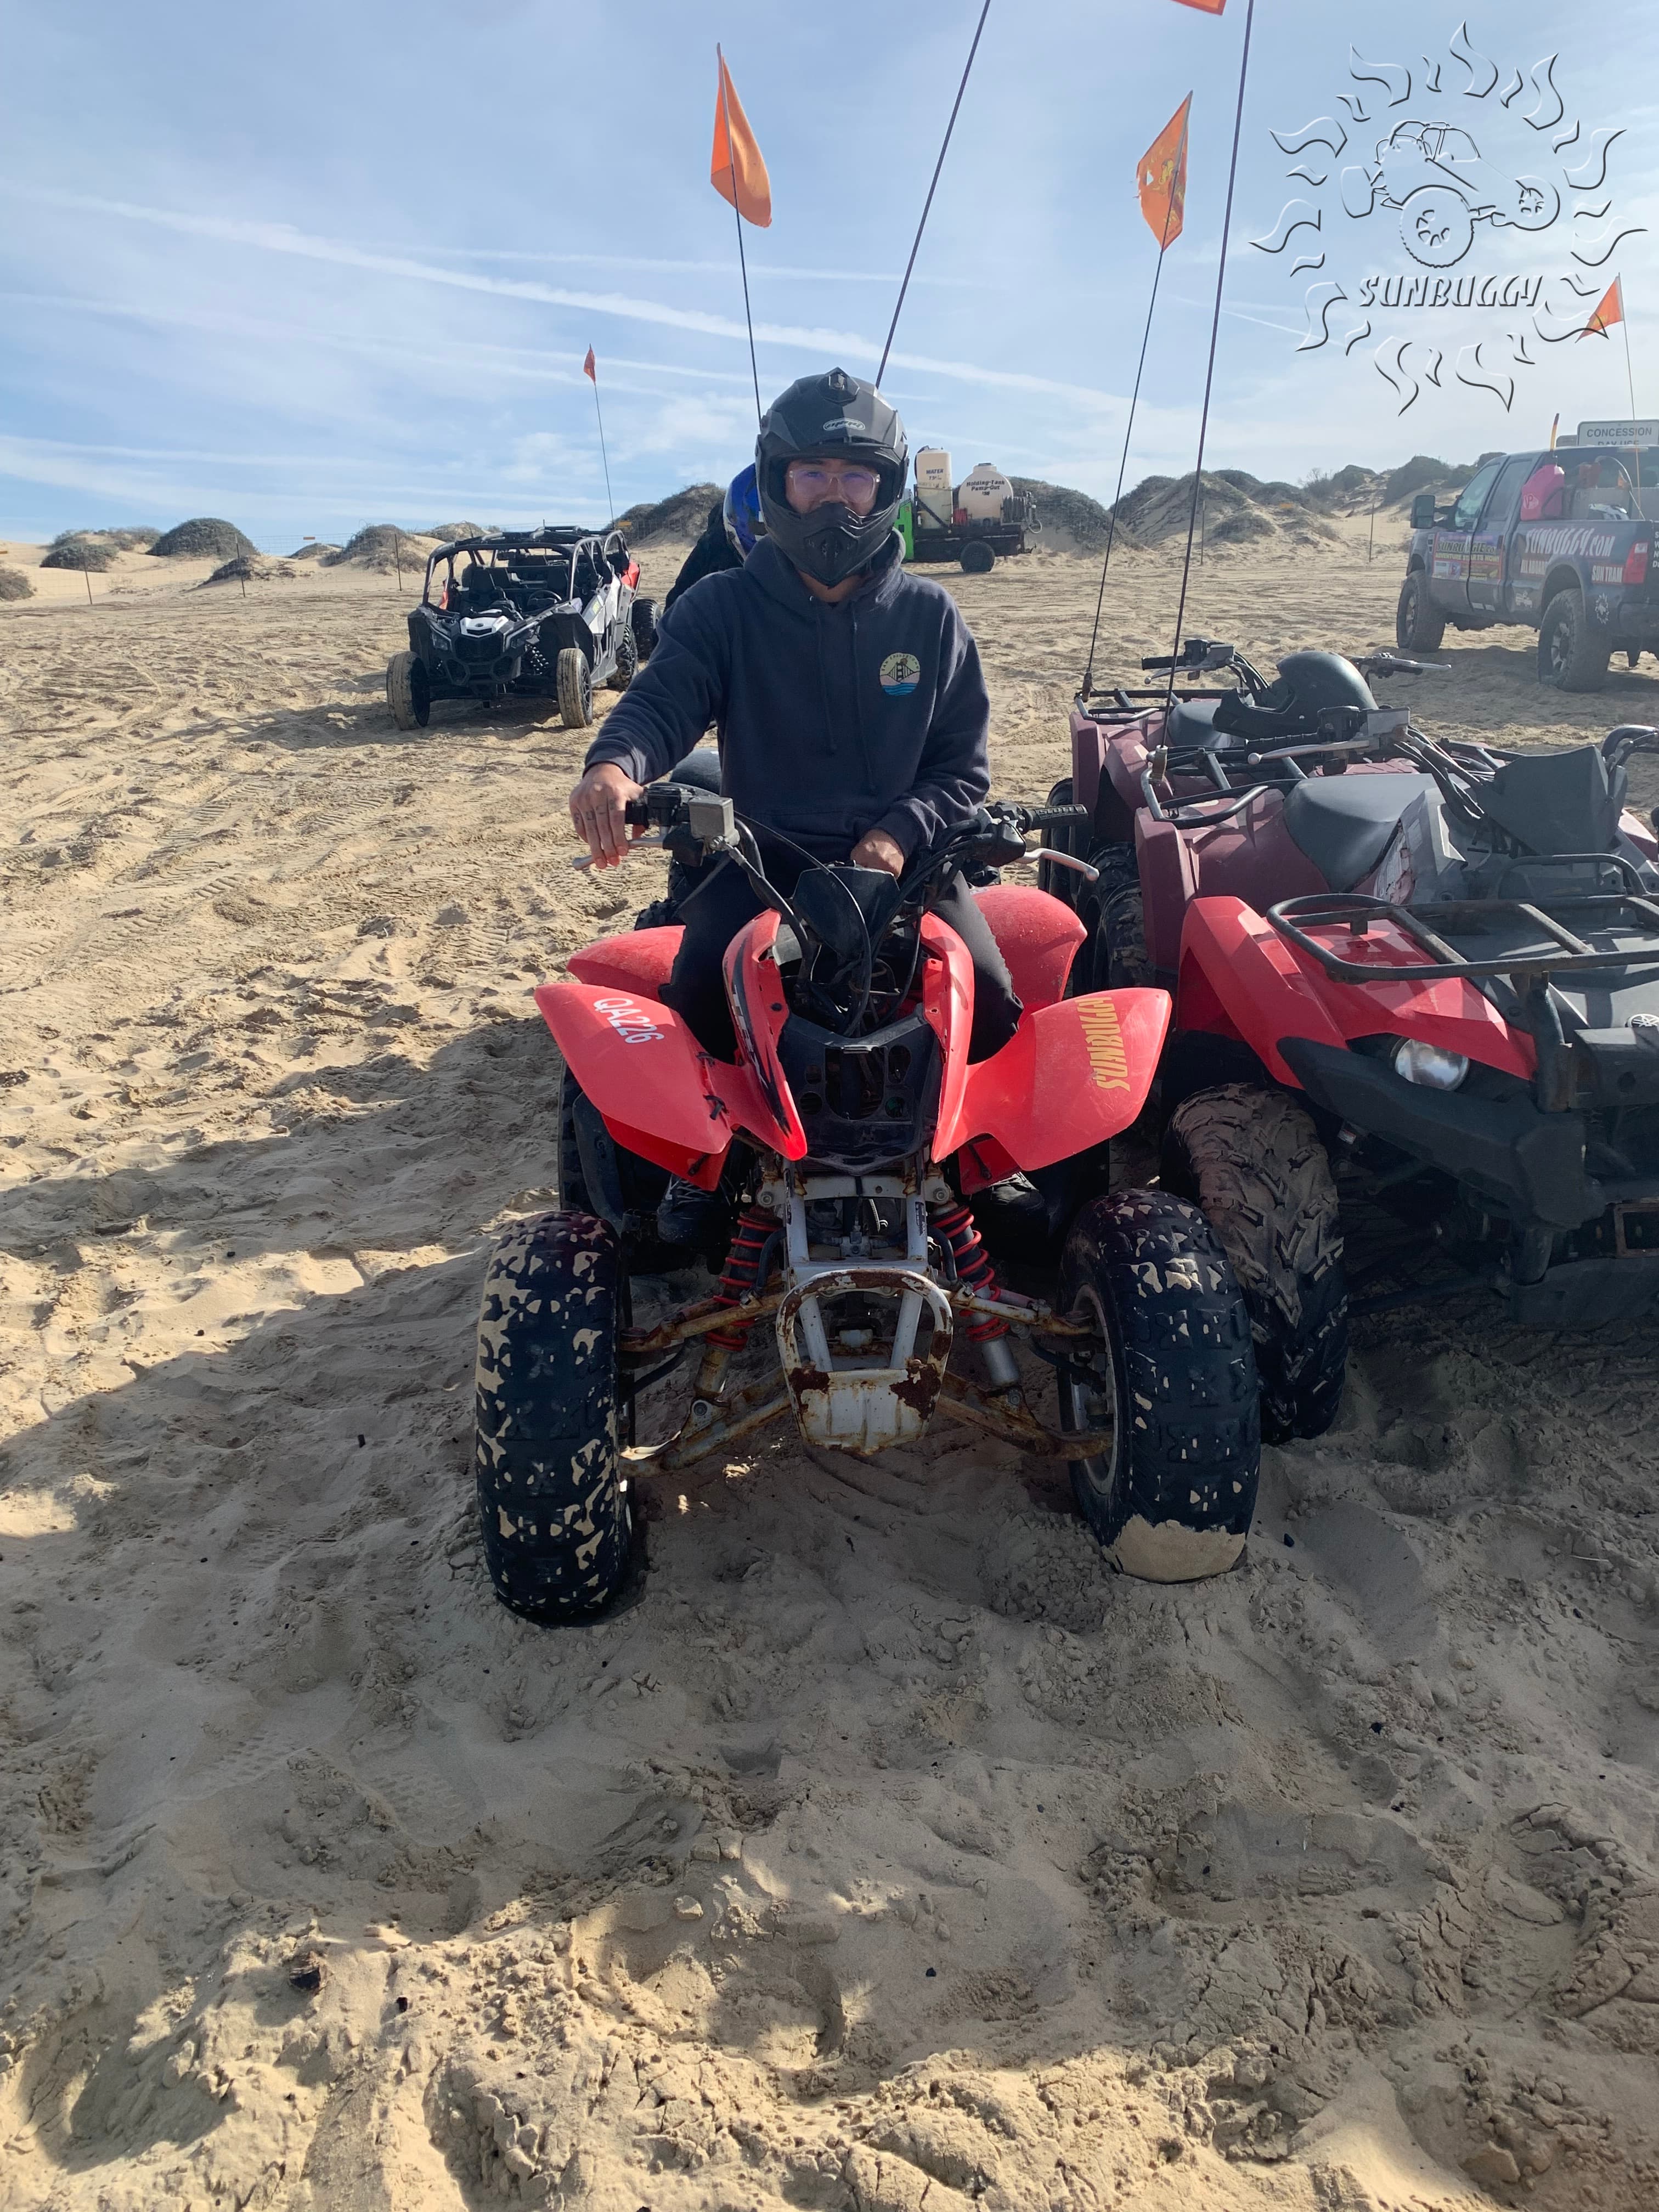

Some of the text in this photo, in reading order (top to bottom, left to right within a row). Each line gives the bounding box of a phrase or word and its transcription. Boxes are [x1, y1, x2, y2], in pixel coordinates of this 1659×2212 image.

[1587, 427, 1652, 437] CONCESSION
[1592, 565, 1623, 583] SUN TRAM
[592, 997, 665, 1044] QA226
[1074, 996, 1131, 1092] SUNBUGGY
